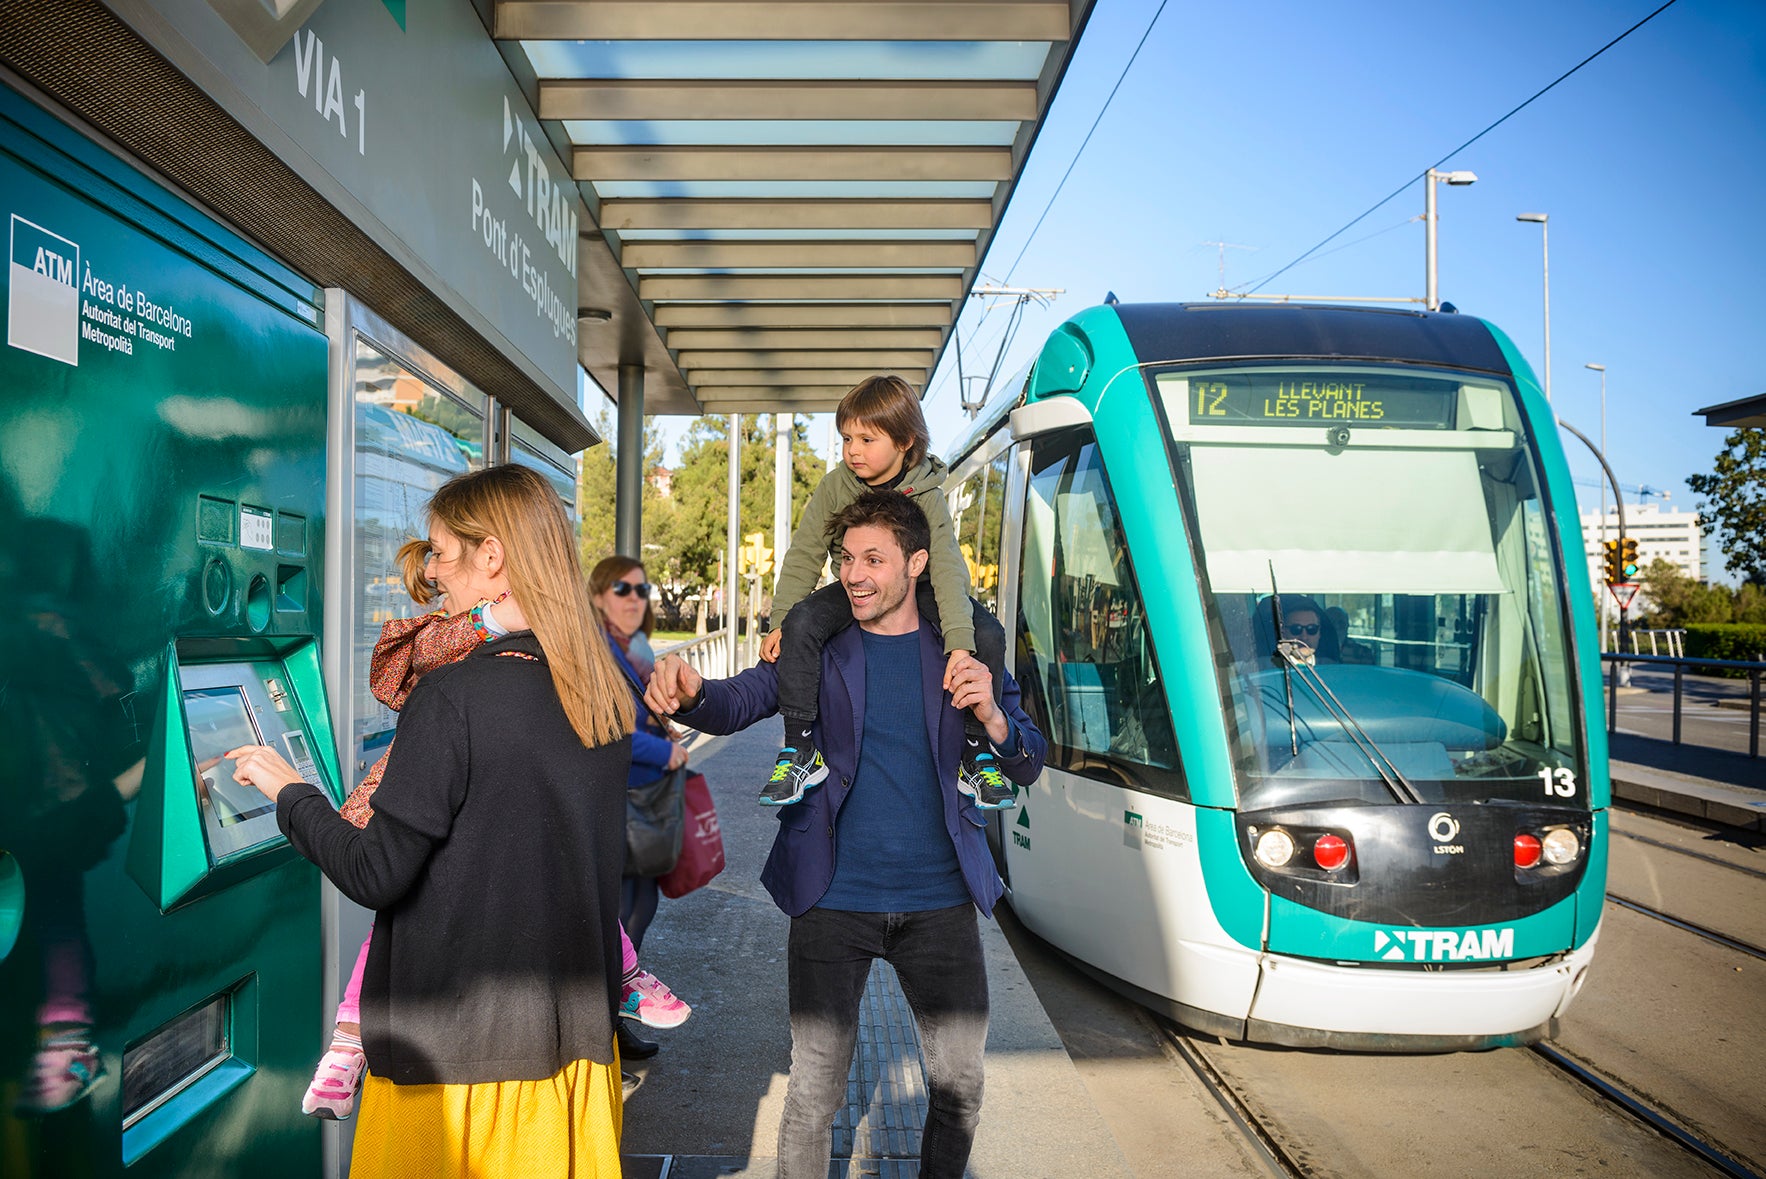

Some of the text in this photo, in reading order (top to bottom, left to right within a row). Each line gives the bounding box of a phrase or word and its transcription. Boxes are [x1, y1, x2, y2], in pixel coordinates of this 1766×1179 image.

[293, 29, 365, 156] VIA 1
[524, 130, 577, 280] TRAM
[33, 246, 73, 288] ATM
[472, 177, 576, 347] Pont d'Esplugues
[82, 260, 192, 338] Àrea de Barcelona
[81, 300, 175, 351] Autoritat del Transport
[81, 321, 133, 355] Metropolità
[1264, 399, 1385, 419] LES PLANES
[1278, 382, 1366, 400] LLEVANT
[1538, 766, 1577, 798] 13
[1012, 830, 1031, 851] TRAM
[1407, 928, 1515, 960] TRAM
